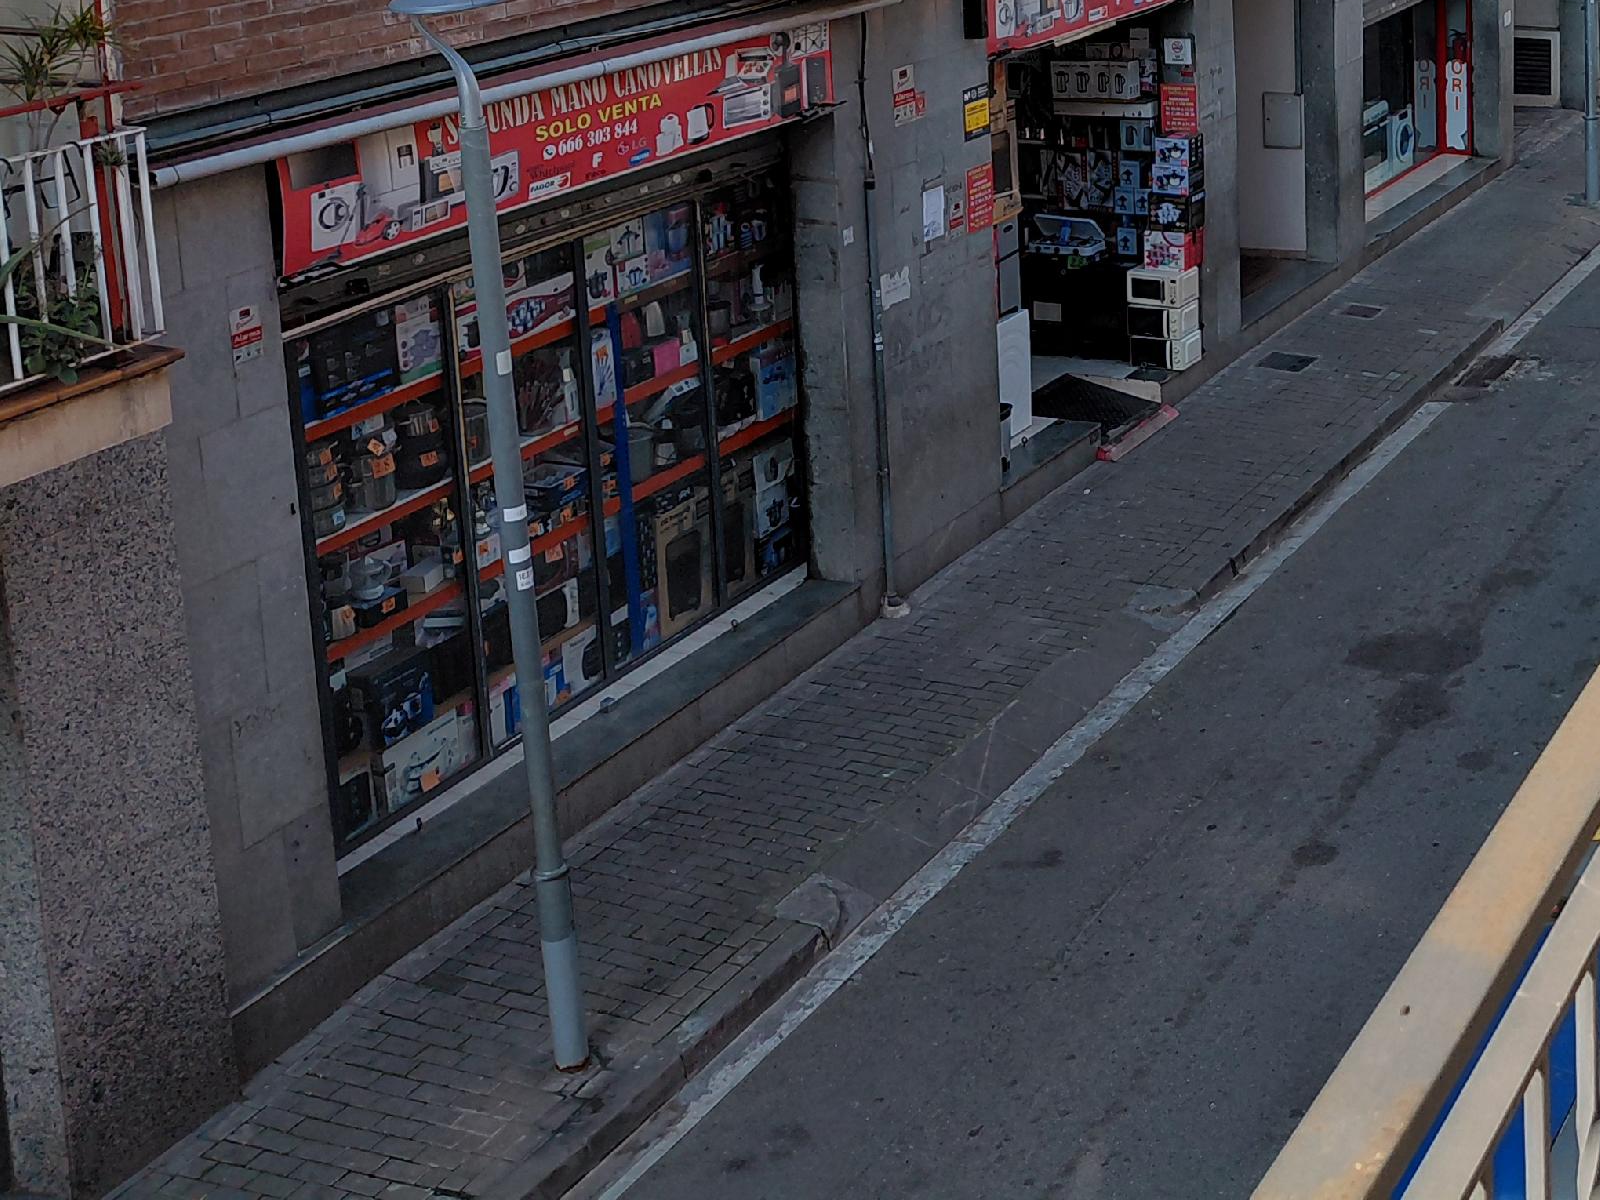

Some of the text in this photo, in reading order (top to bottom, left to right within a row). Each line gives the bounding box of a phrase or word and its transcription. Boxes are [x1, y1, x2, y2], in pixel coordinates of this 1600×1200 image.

[443, 48, 722, 146] SUNDA MANO CANOVELLAS
[534, 92, 663, 143] SOLO VENTA
[558, 118, 638, 157] 666 303 844
